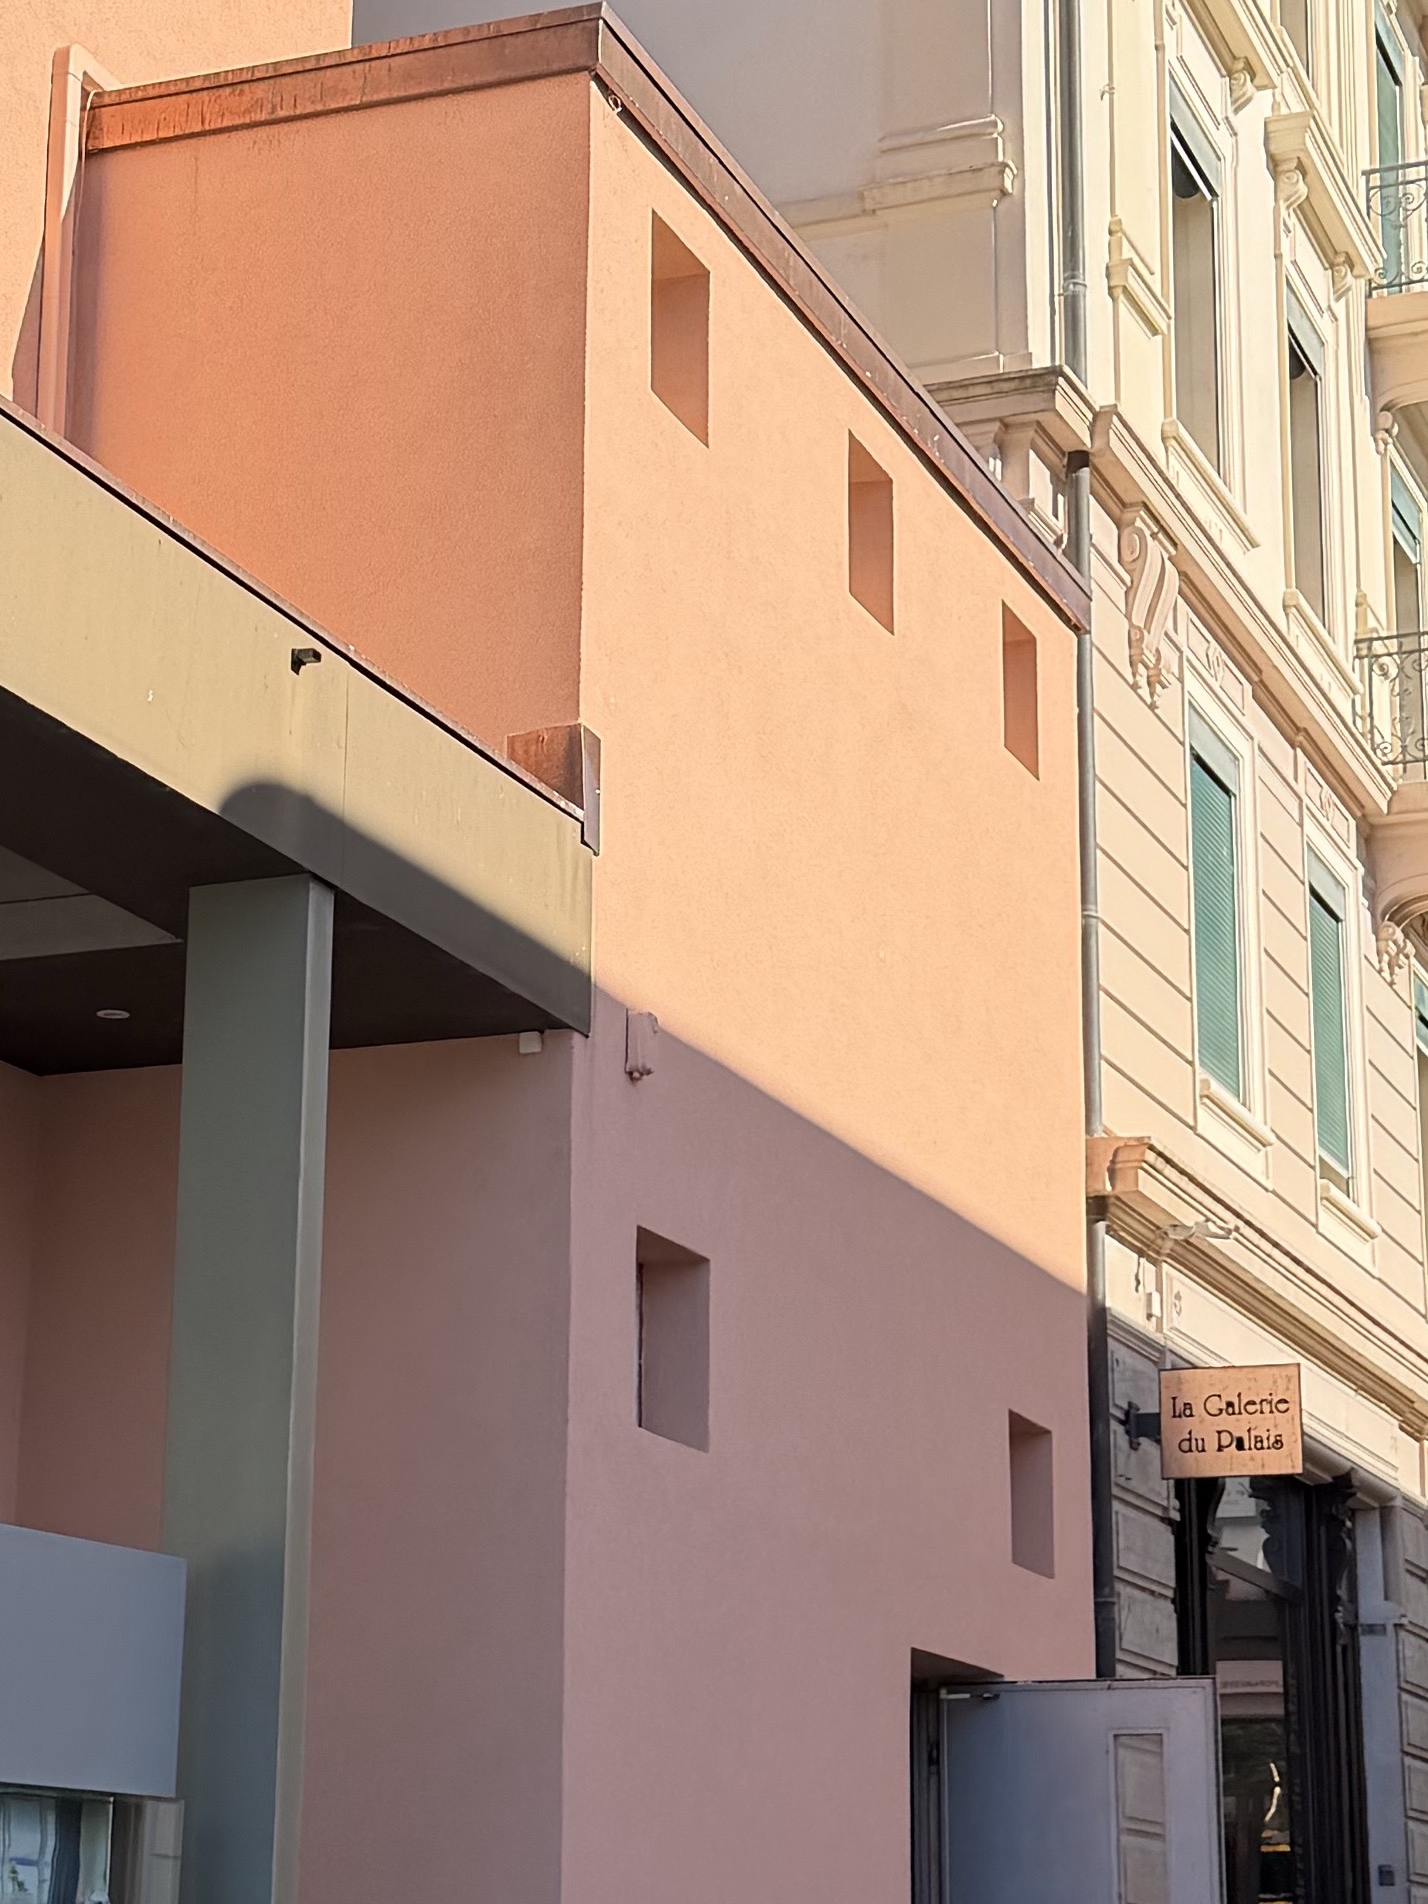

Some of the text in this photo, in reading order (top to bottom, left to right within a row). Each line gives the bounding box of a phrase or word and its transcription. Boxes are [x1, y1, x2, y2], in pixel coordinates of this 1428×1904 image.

[1171, 1391, 1290, 1419] La Galerie
[1178, 1426, 1284, 1454] du Palais
